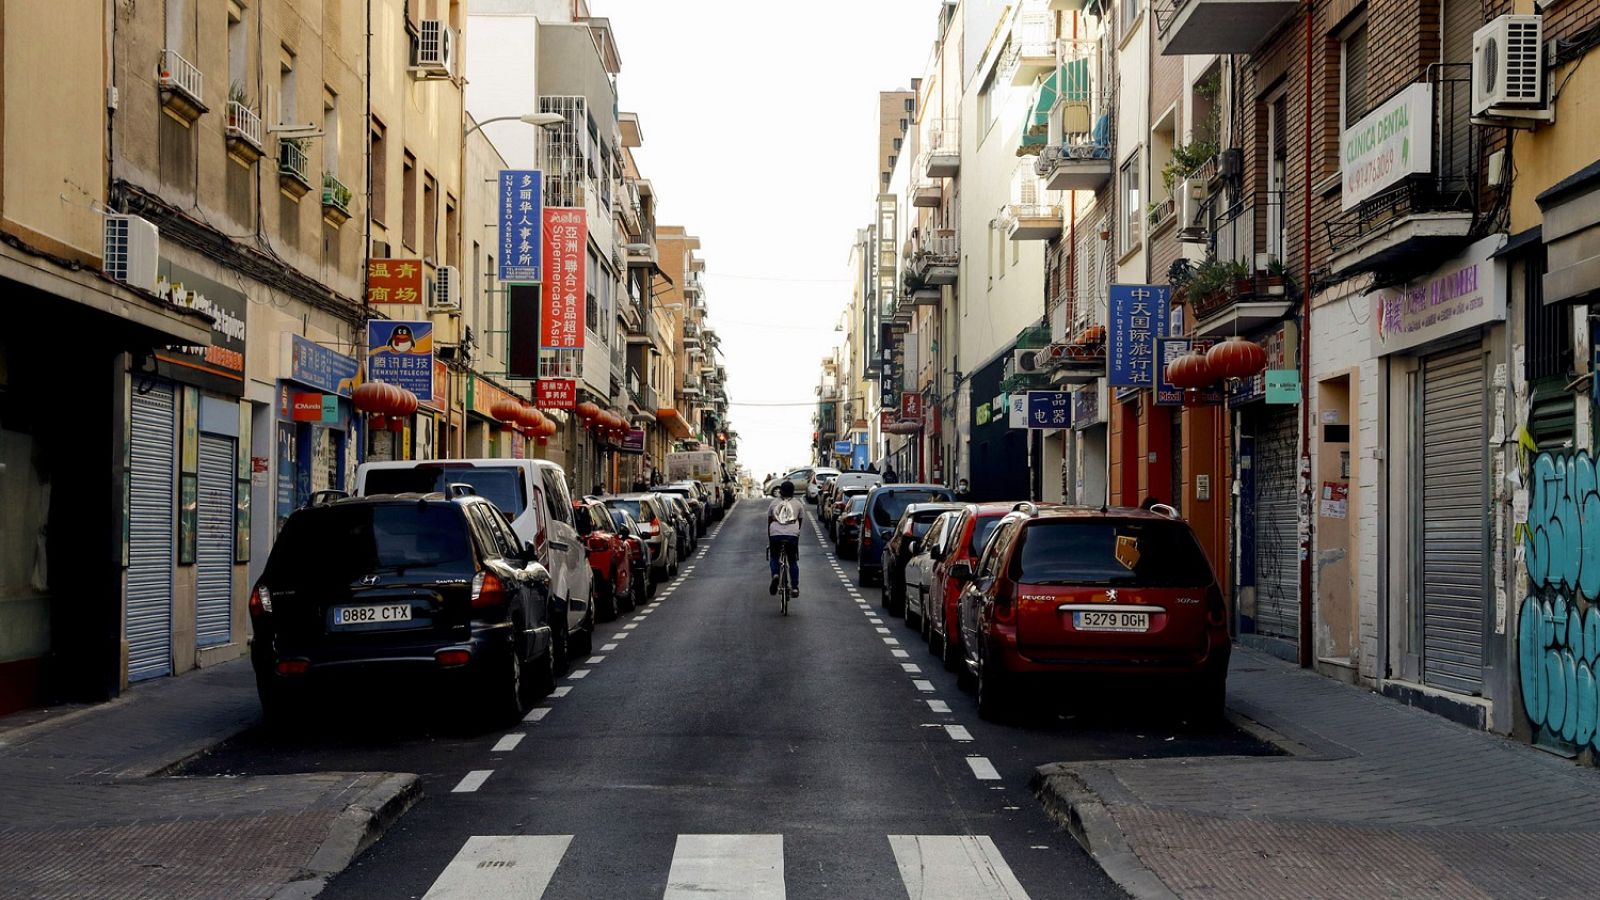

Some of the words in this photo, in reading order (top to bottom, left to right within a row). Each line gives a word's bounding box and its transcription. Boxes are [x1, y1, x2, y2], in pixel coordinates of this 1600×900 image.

[1378, 104, 1409, 144] DENTAL
[505, 175, 513, 220] UNIVERSO
[518, 174, 533, 266] 多丽华人事务所
[369, 263, 418, 278] 温青
[551, 225, 563, 316] Supermercado
[1431, 264, 1478, 305] HANMEI
[368, 287, 418, 302] 商场
[1157, 289, 1165, 319] VIAJES
[551, 319, 562, 347] Asia
[1128, 288, 1152, 382] 中天国际旅行社
[1033, 394, 1065, 406] 一品
[1034, 409, 1065, 424] 电器
[342, 608, 376, 621] 0882
[381, 606, 409, 619] CTX
[1084, 613, 1117, 626] 5279
[1121, 613, 1147, 626] DGH
